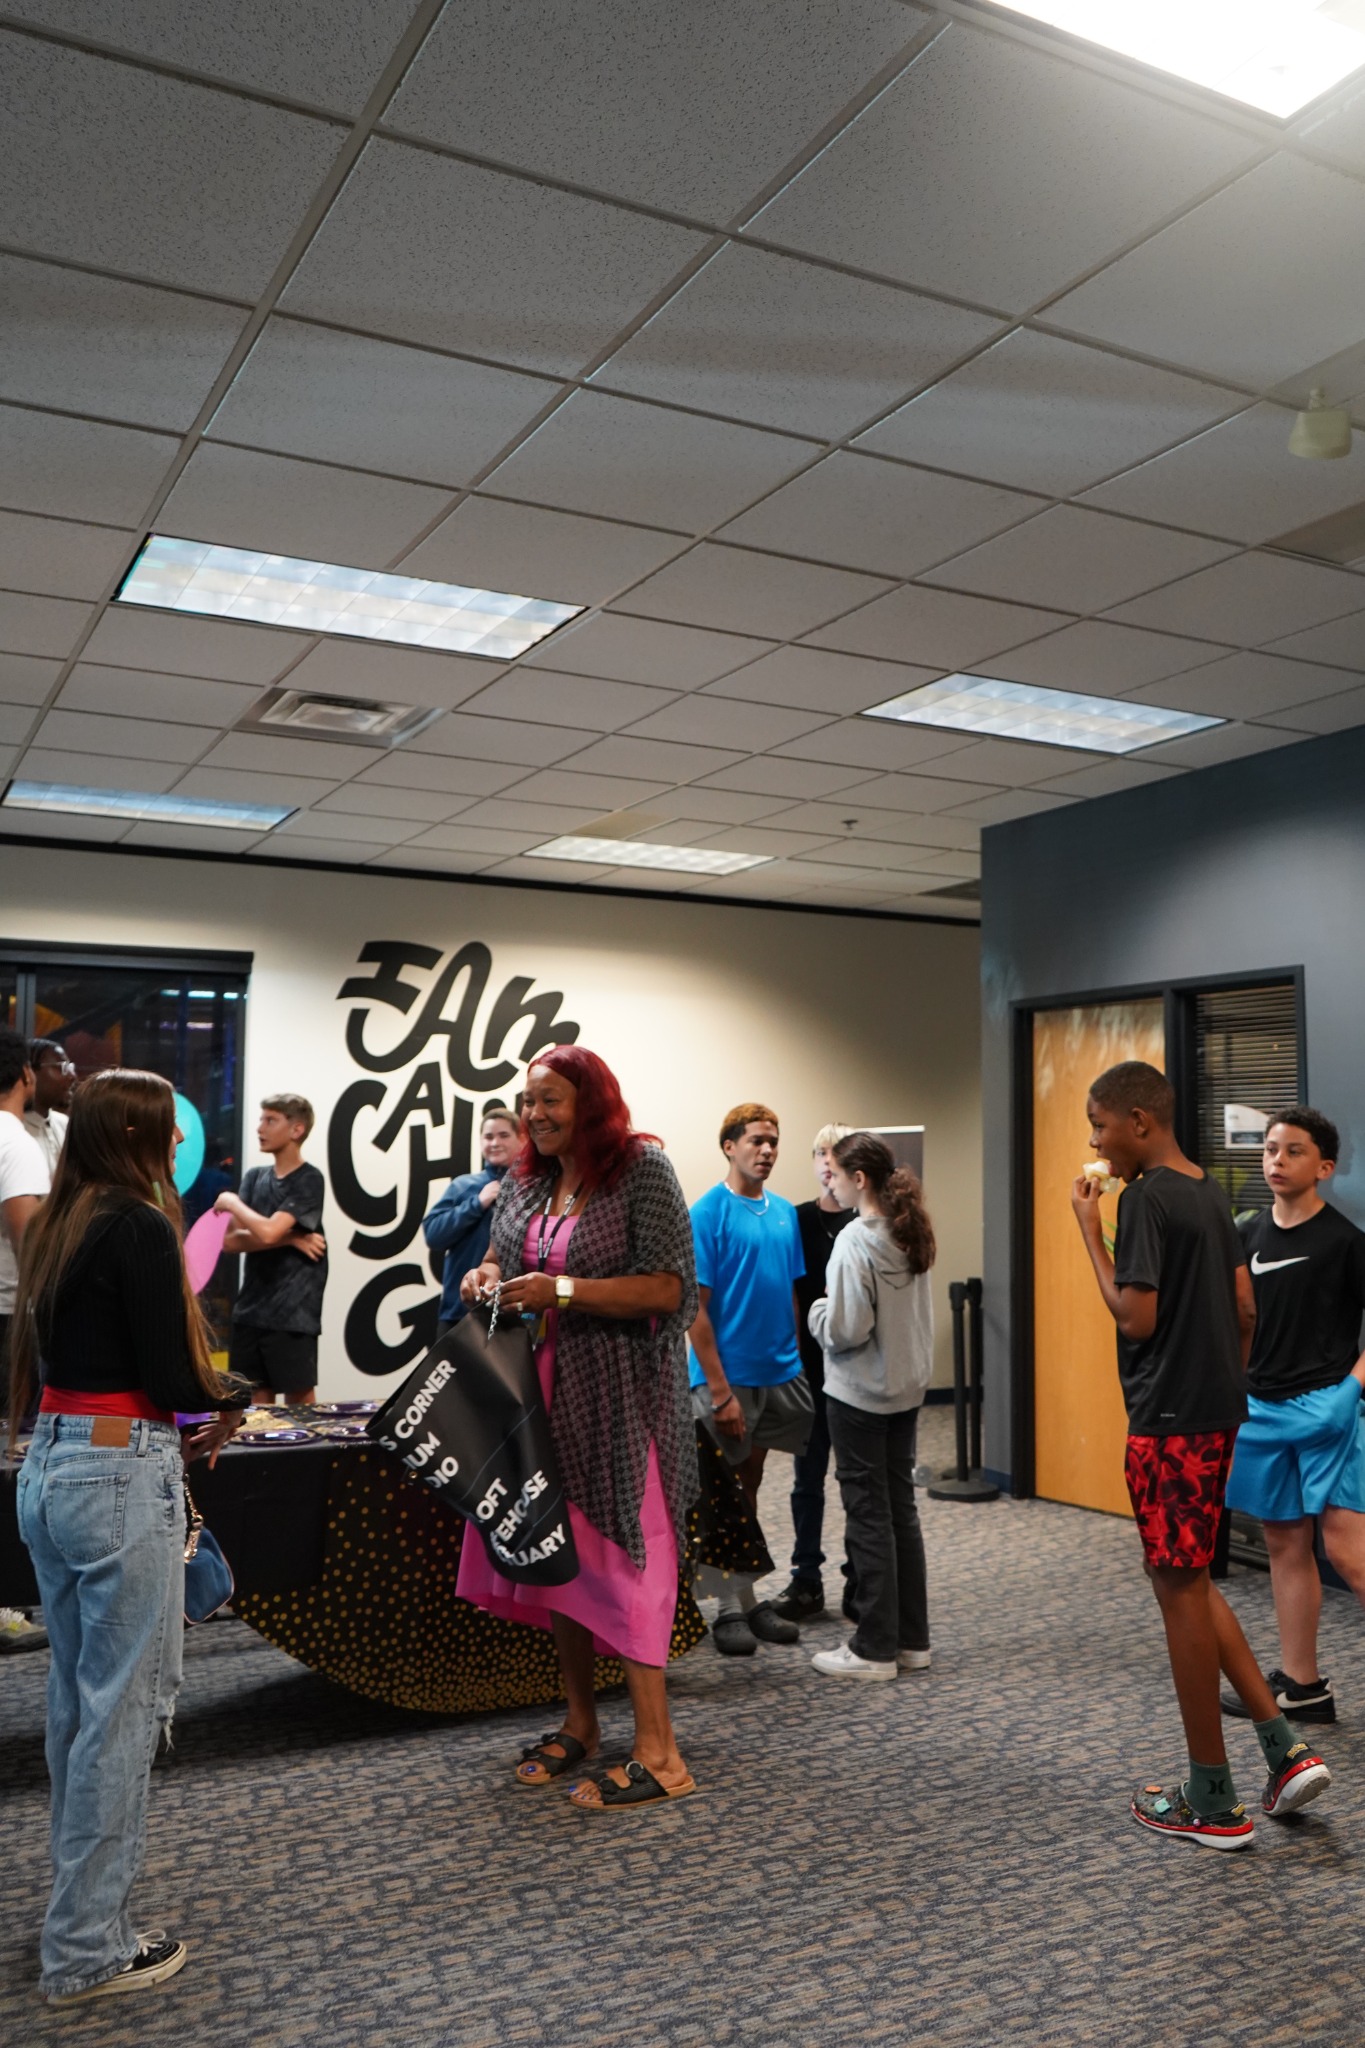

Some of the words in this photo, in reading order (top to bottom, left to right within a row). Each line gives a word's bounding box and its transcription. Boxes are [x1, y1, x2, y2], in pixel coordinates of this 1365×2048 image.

[337, 940, 444, 1015] I
[394, 1359, 457, 1440] CORNER
[475, 1477, 508, 1523] OFT
